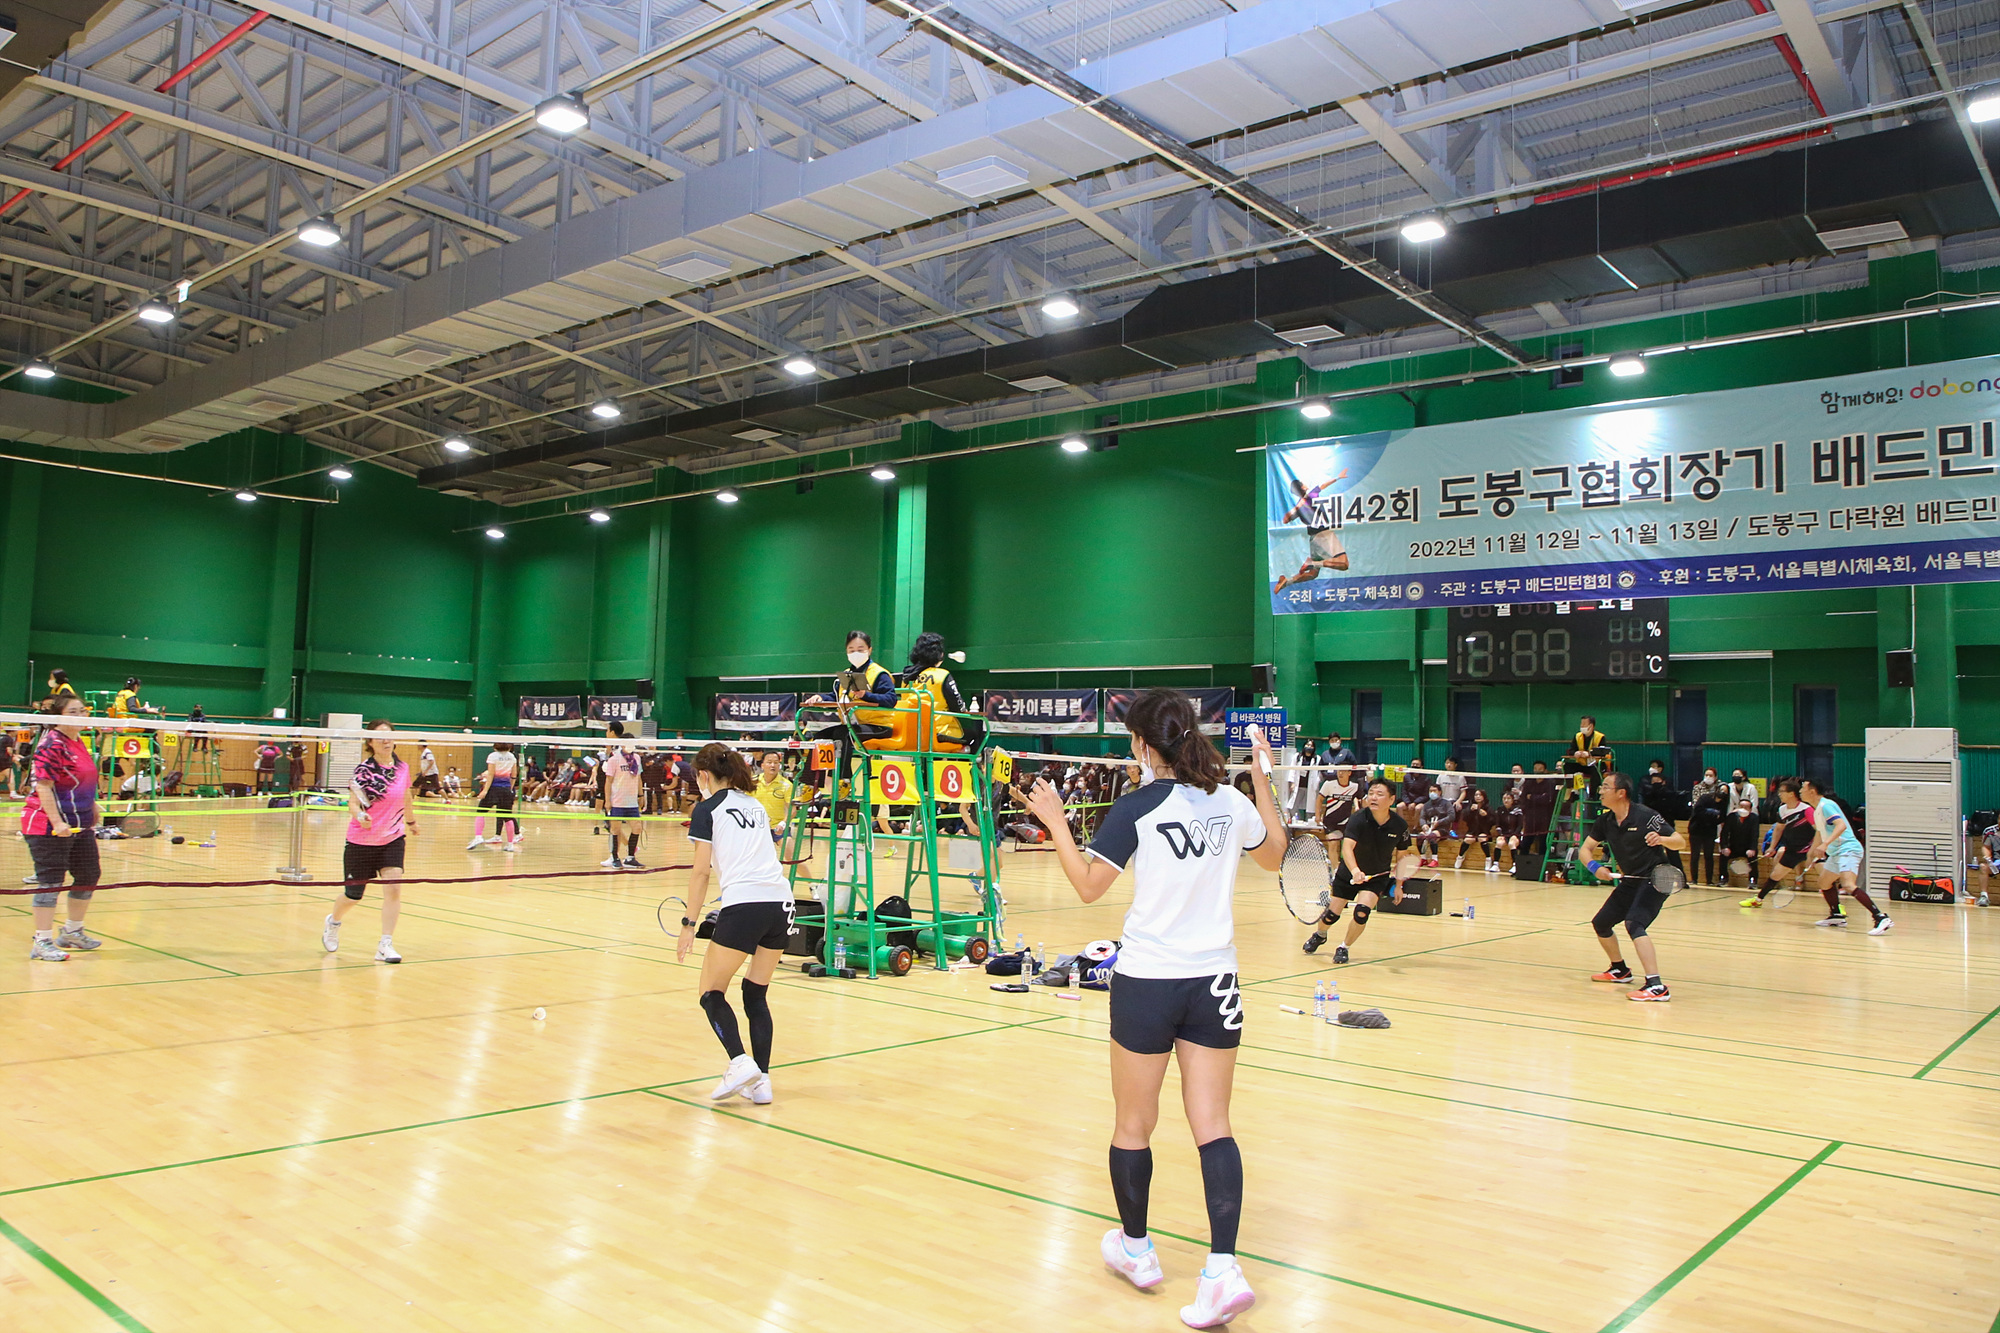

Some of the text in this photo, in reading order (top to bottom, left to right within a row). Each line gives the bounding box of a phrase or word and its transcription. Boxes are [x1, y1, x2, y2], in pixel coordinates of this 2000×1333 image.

[1820, 387, 1903, 414] 함께해요!
[1311, 420, 1996, 529] 제42회 도봉구협회장기 배드민
[1409, 536, 1476, 559] 2022년
[1484, 532, 1526, 553] 11월
[1535, 528, 1580, 550] 12일
[1611, 523, 1658, 545] 11월
[1668, 519, 1718, 541] 13일
[1748, 511, 1819, 537] 도봉구
[1830, 504, 1905, 531] 다락원
[1917, 497, 1998, 525] 배드민
[1658, 568, 1690, 585] 후원
[1706, 564, 1761, 582] 도봉구,
[1767, 554, 1917, 580] 서울특별시체육회,
[1324, 587, 1360, 602] 도봉구
[1364, 585, 1402, 600] 체육회
[1480, 579, 1521, 595] 도봉구
[1525, 573, 1612, 593] 배드민턴협회
[730, 700, 780, 716] 초안산클럽
[998, 698, 1083, 717] 스카이콕클럽
[1239, 713, 1281, 724] 바로선 병원
[128, 741, 137, 752] 5
[165, 735, 176, 744] 20
[819, 749, 833, 763] 20
[1000, 760, 1010, 776] 18
[885, 772, 900, 793] 9
[947, 769, 959, 793] 8
